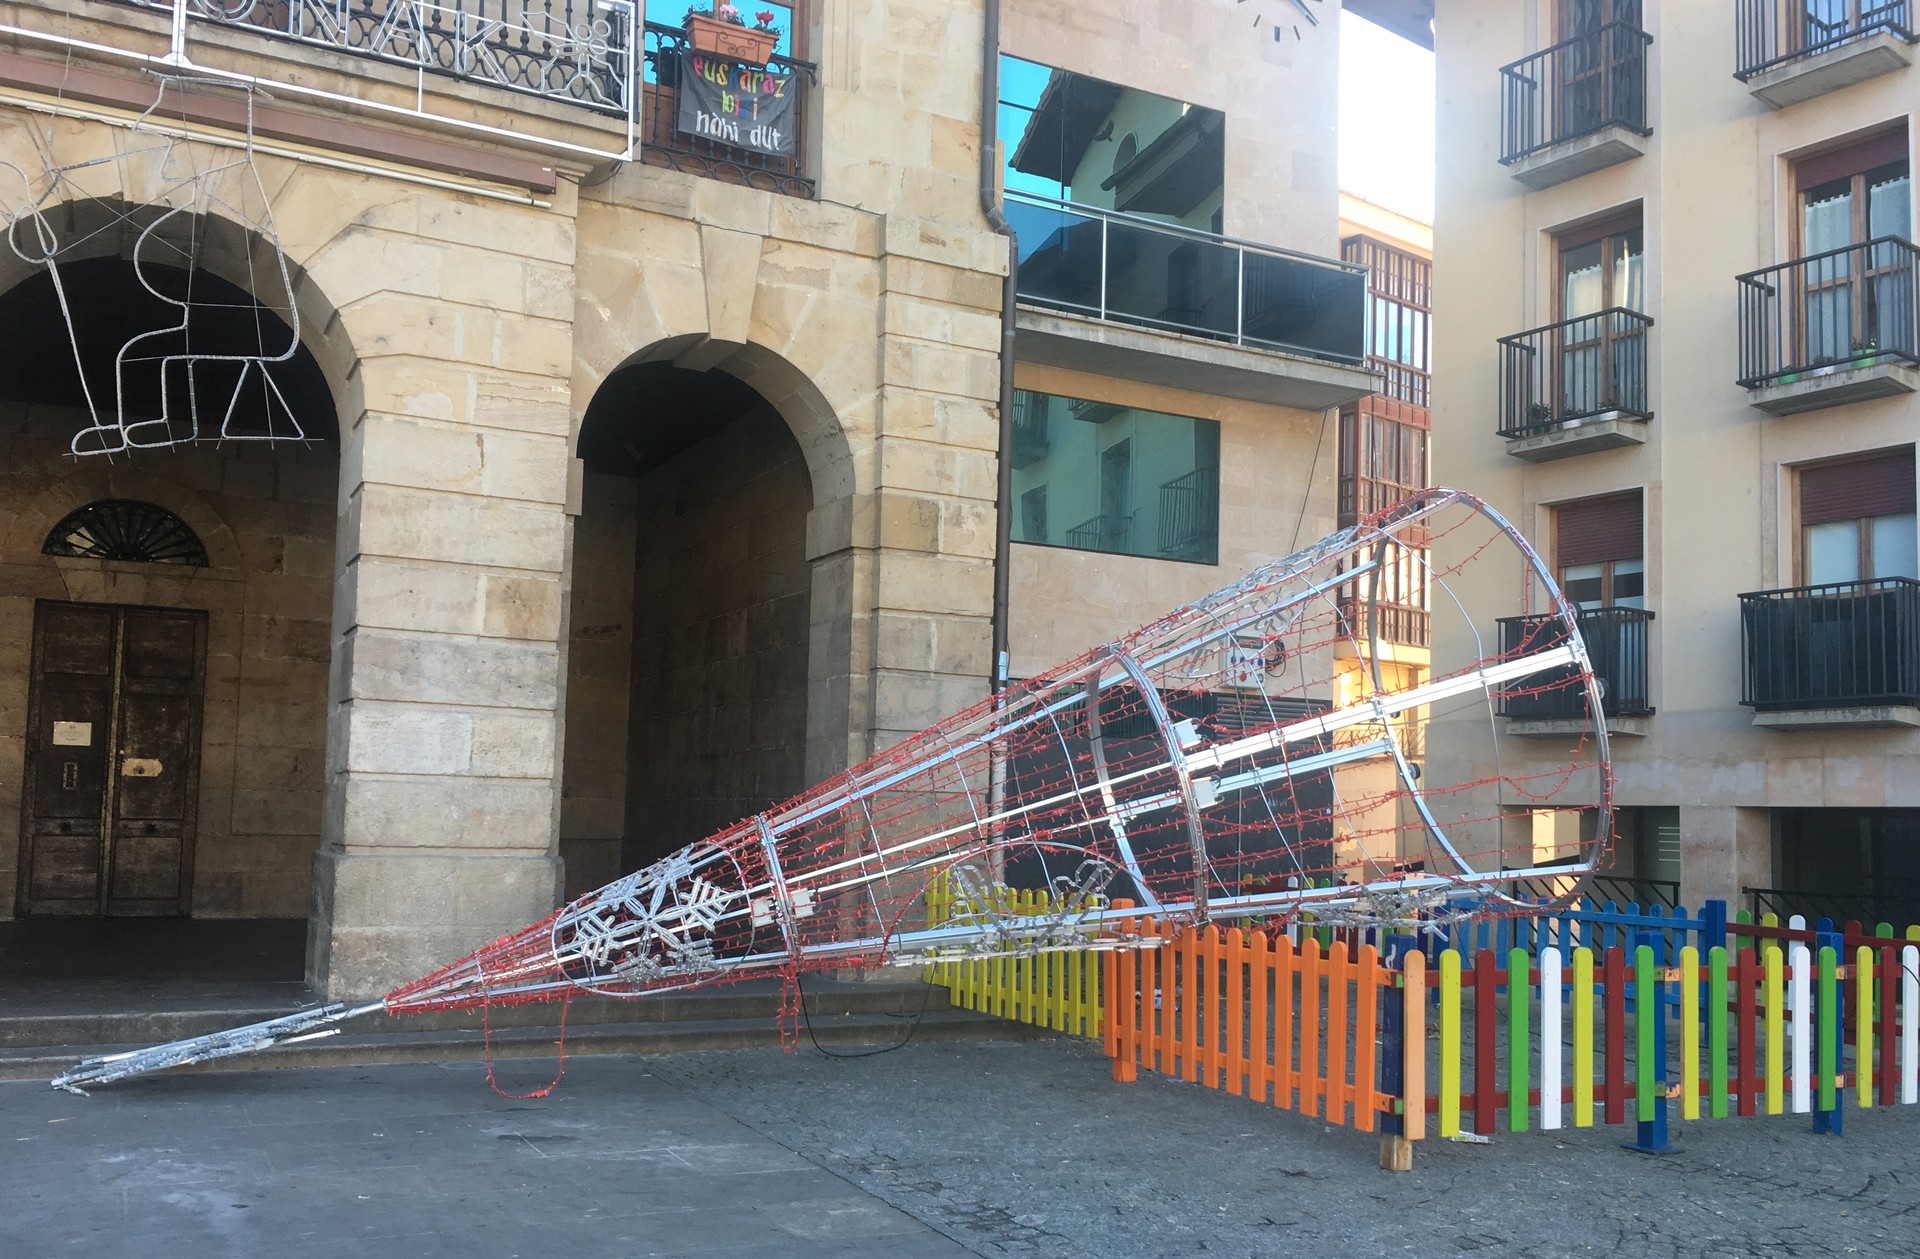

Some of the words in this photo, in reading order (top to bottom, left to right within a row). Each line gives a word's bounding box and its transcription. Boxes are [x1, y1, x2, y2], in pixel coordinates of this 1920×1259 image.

[693, 55, 786, 98] euskaraz
[722, 90, 758, 120] bizi
[696, 110, 739, 142] nahi
[750, 125, 781, 150] dut
